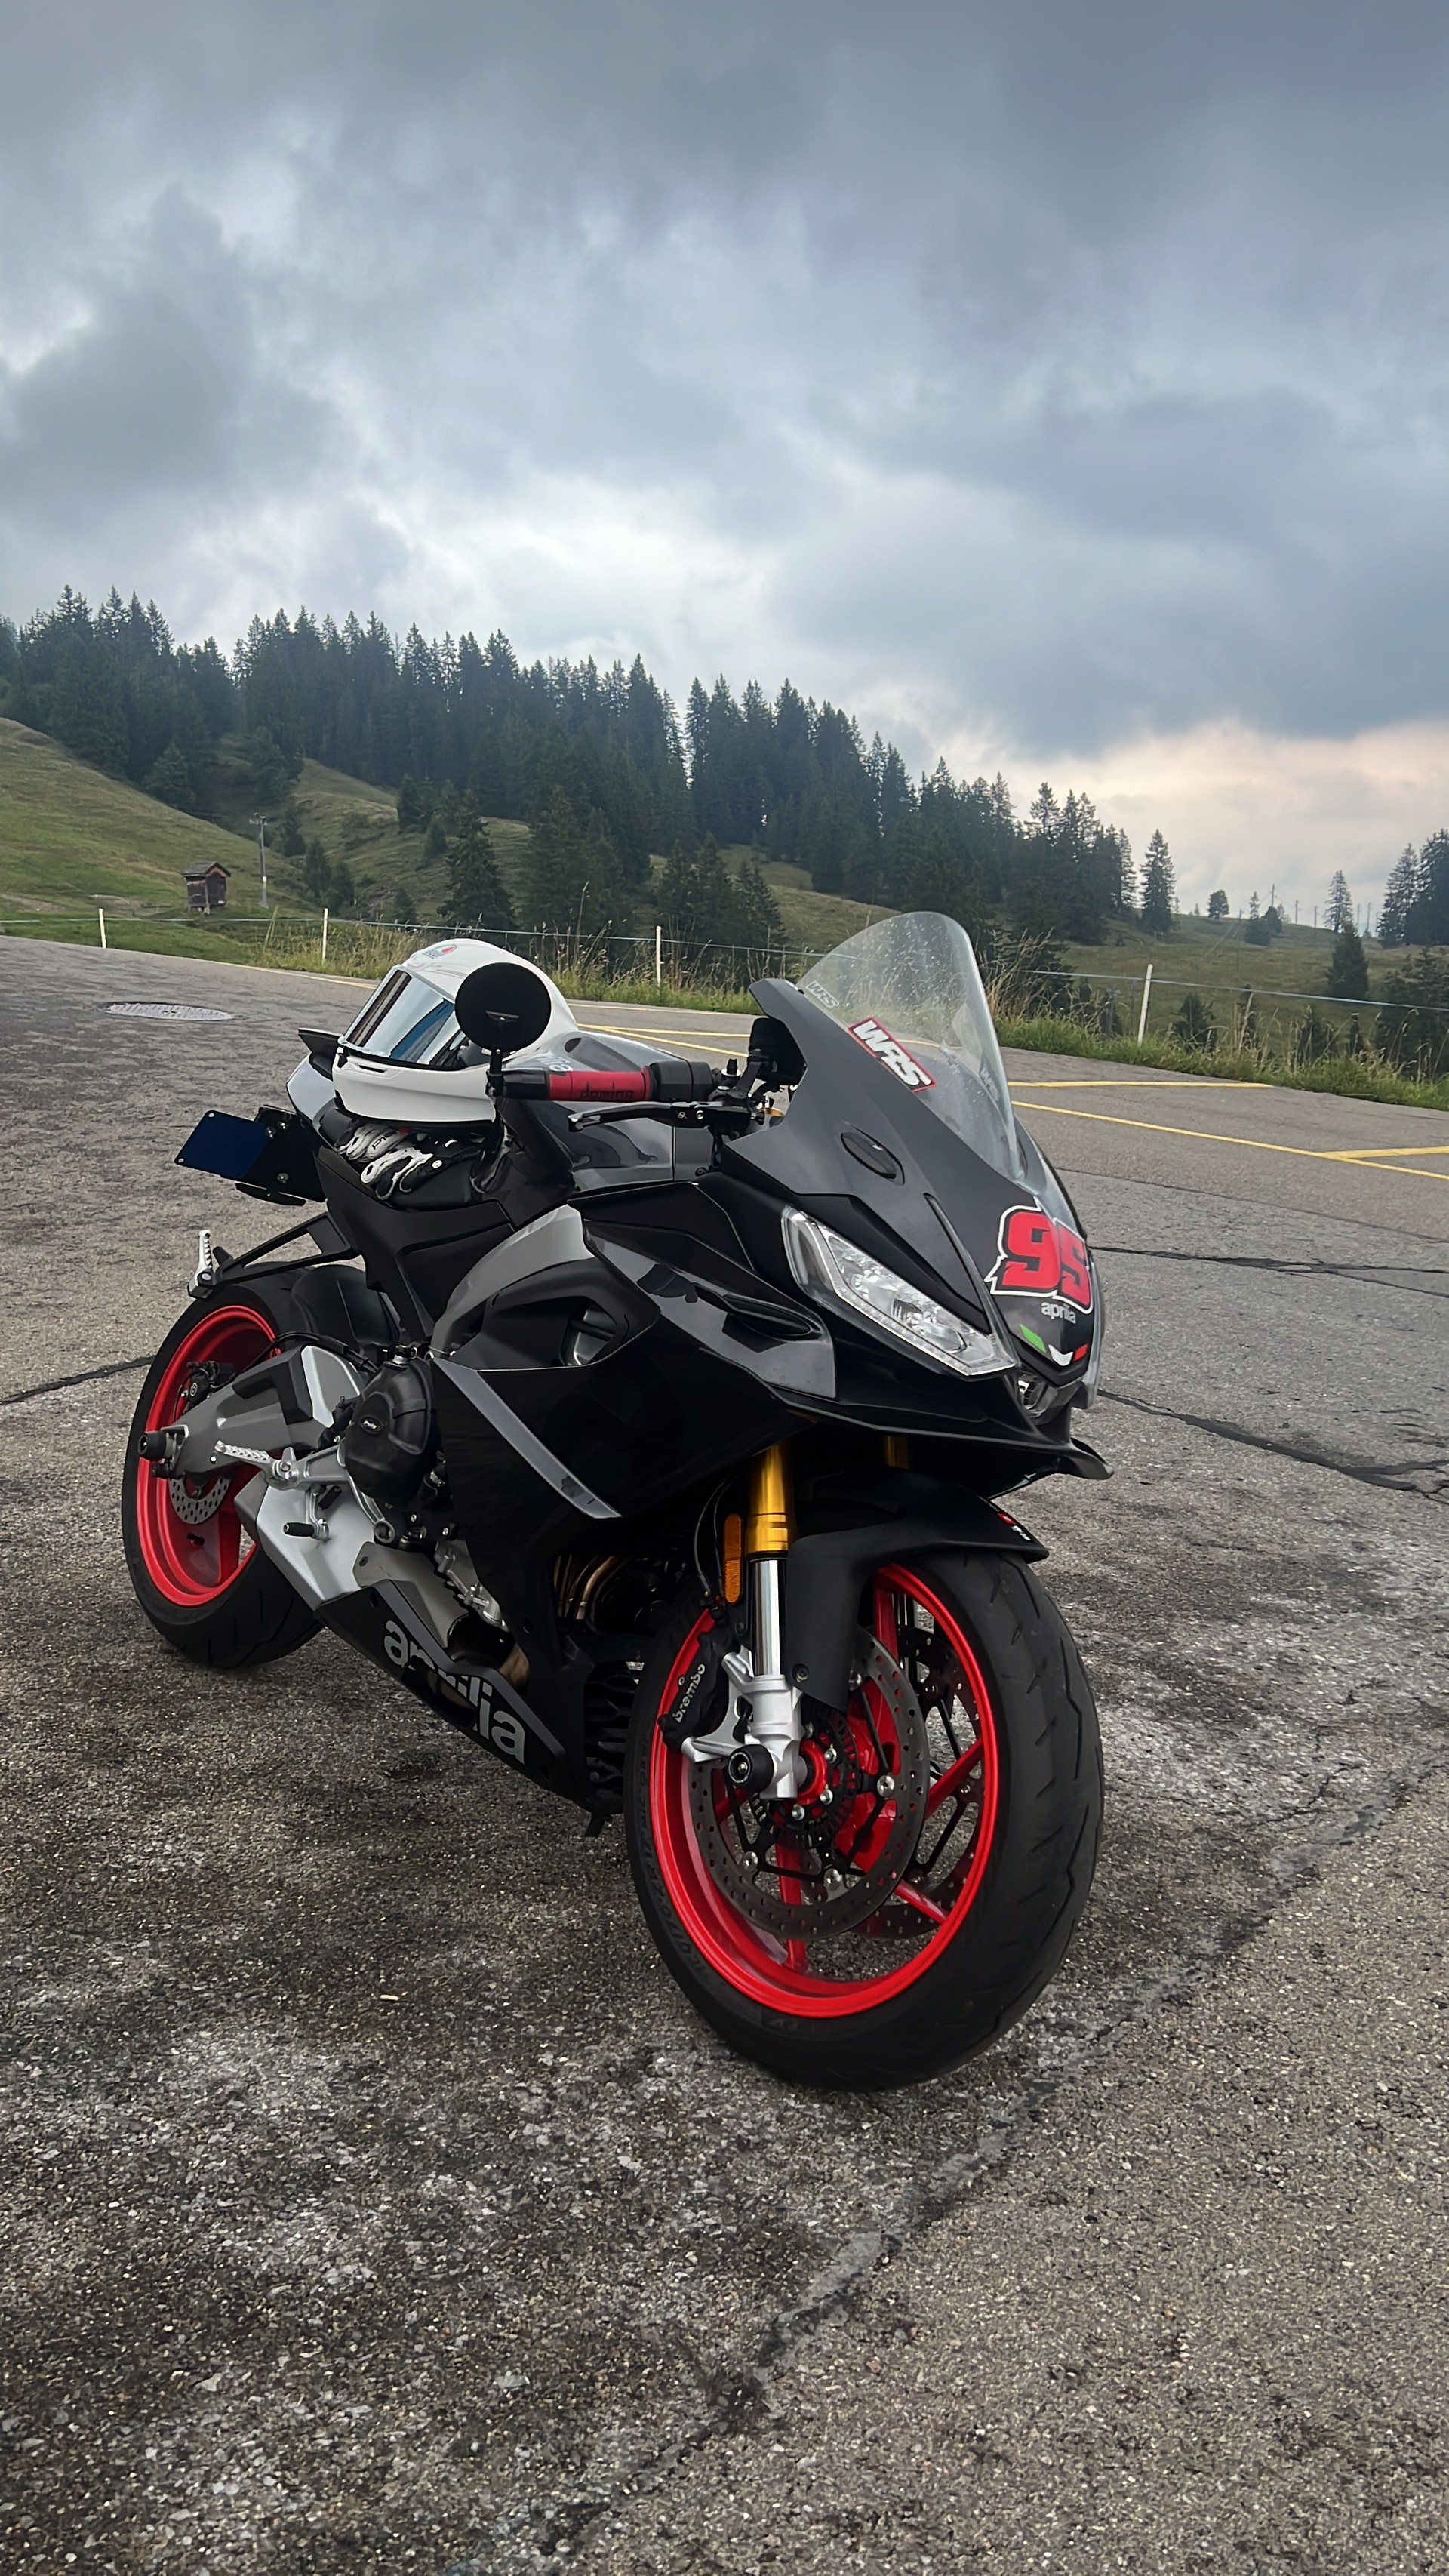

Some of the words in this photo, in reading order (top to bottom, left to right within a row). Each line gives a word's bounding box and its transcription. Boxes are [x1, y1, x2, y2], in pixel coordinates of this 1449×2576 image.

[536, 1056, 574, 1072] ilia
[853, 1020, 931, 1085] WRS
[580, 1080, 635, 1100] domino
[1002, 1211, 1091, 1306] 95
[672, 1663, 706, 1723] brembo
